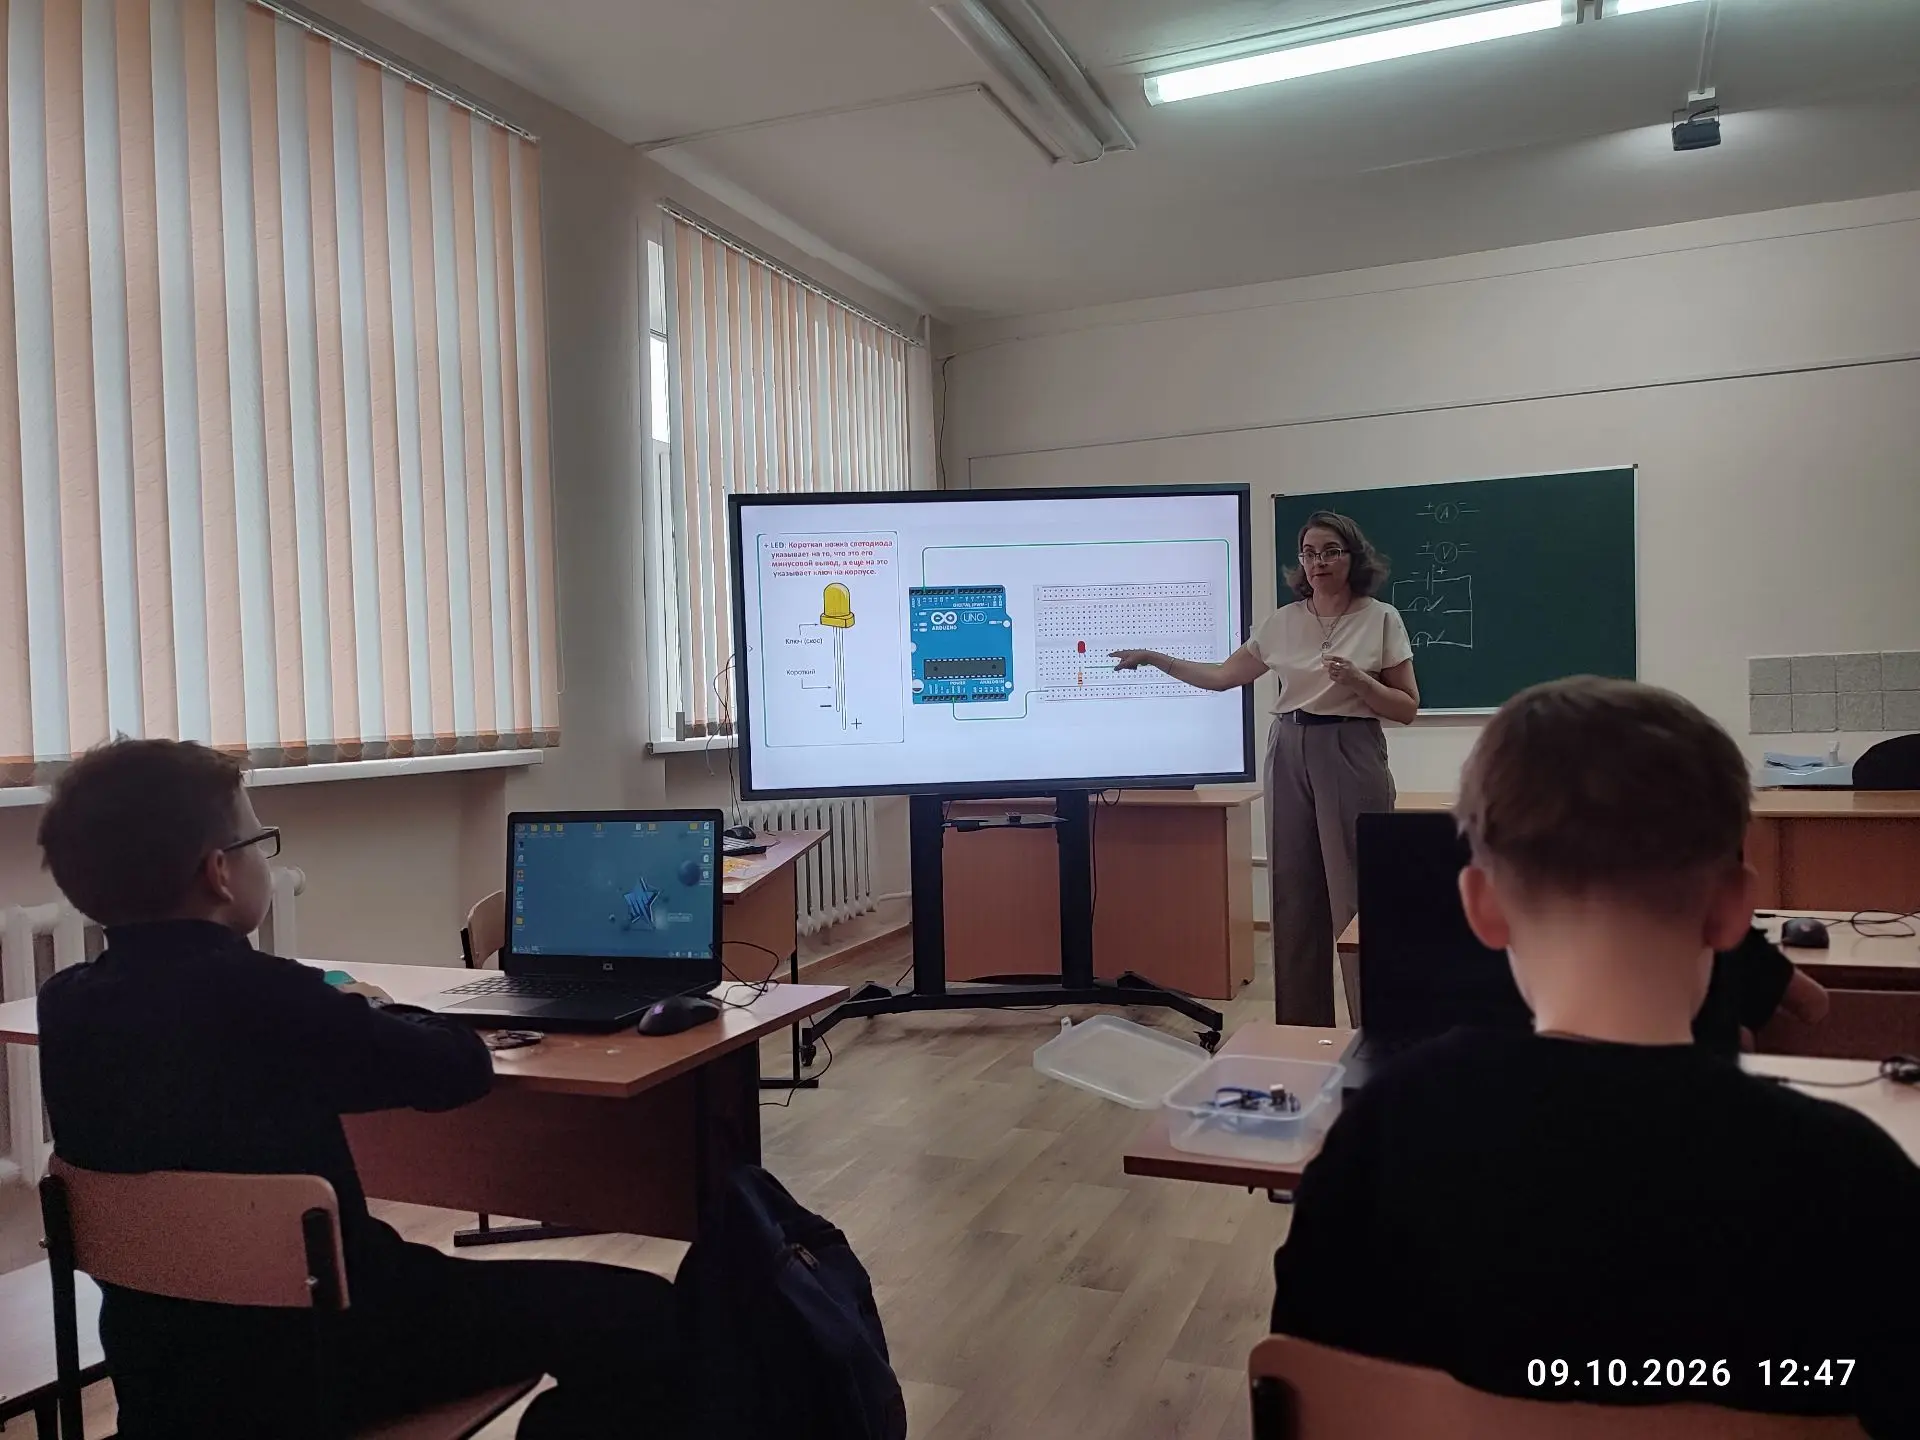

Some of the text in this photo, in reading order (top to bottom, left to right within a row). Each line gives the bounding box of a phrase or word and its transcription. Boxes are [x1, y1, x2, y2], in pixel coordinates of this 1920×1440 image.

[771, 551, 809, 559] указывает
[773, 569, 812, 577] указывает
[963, 612, 985, 622] UNO
